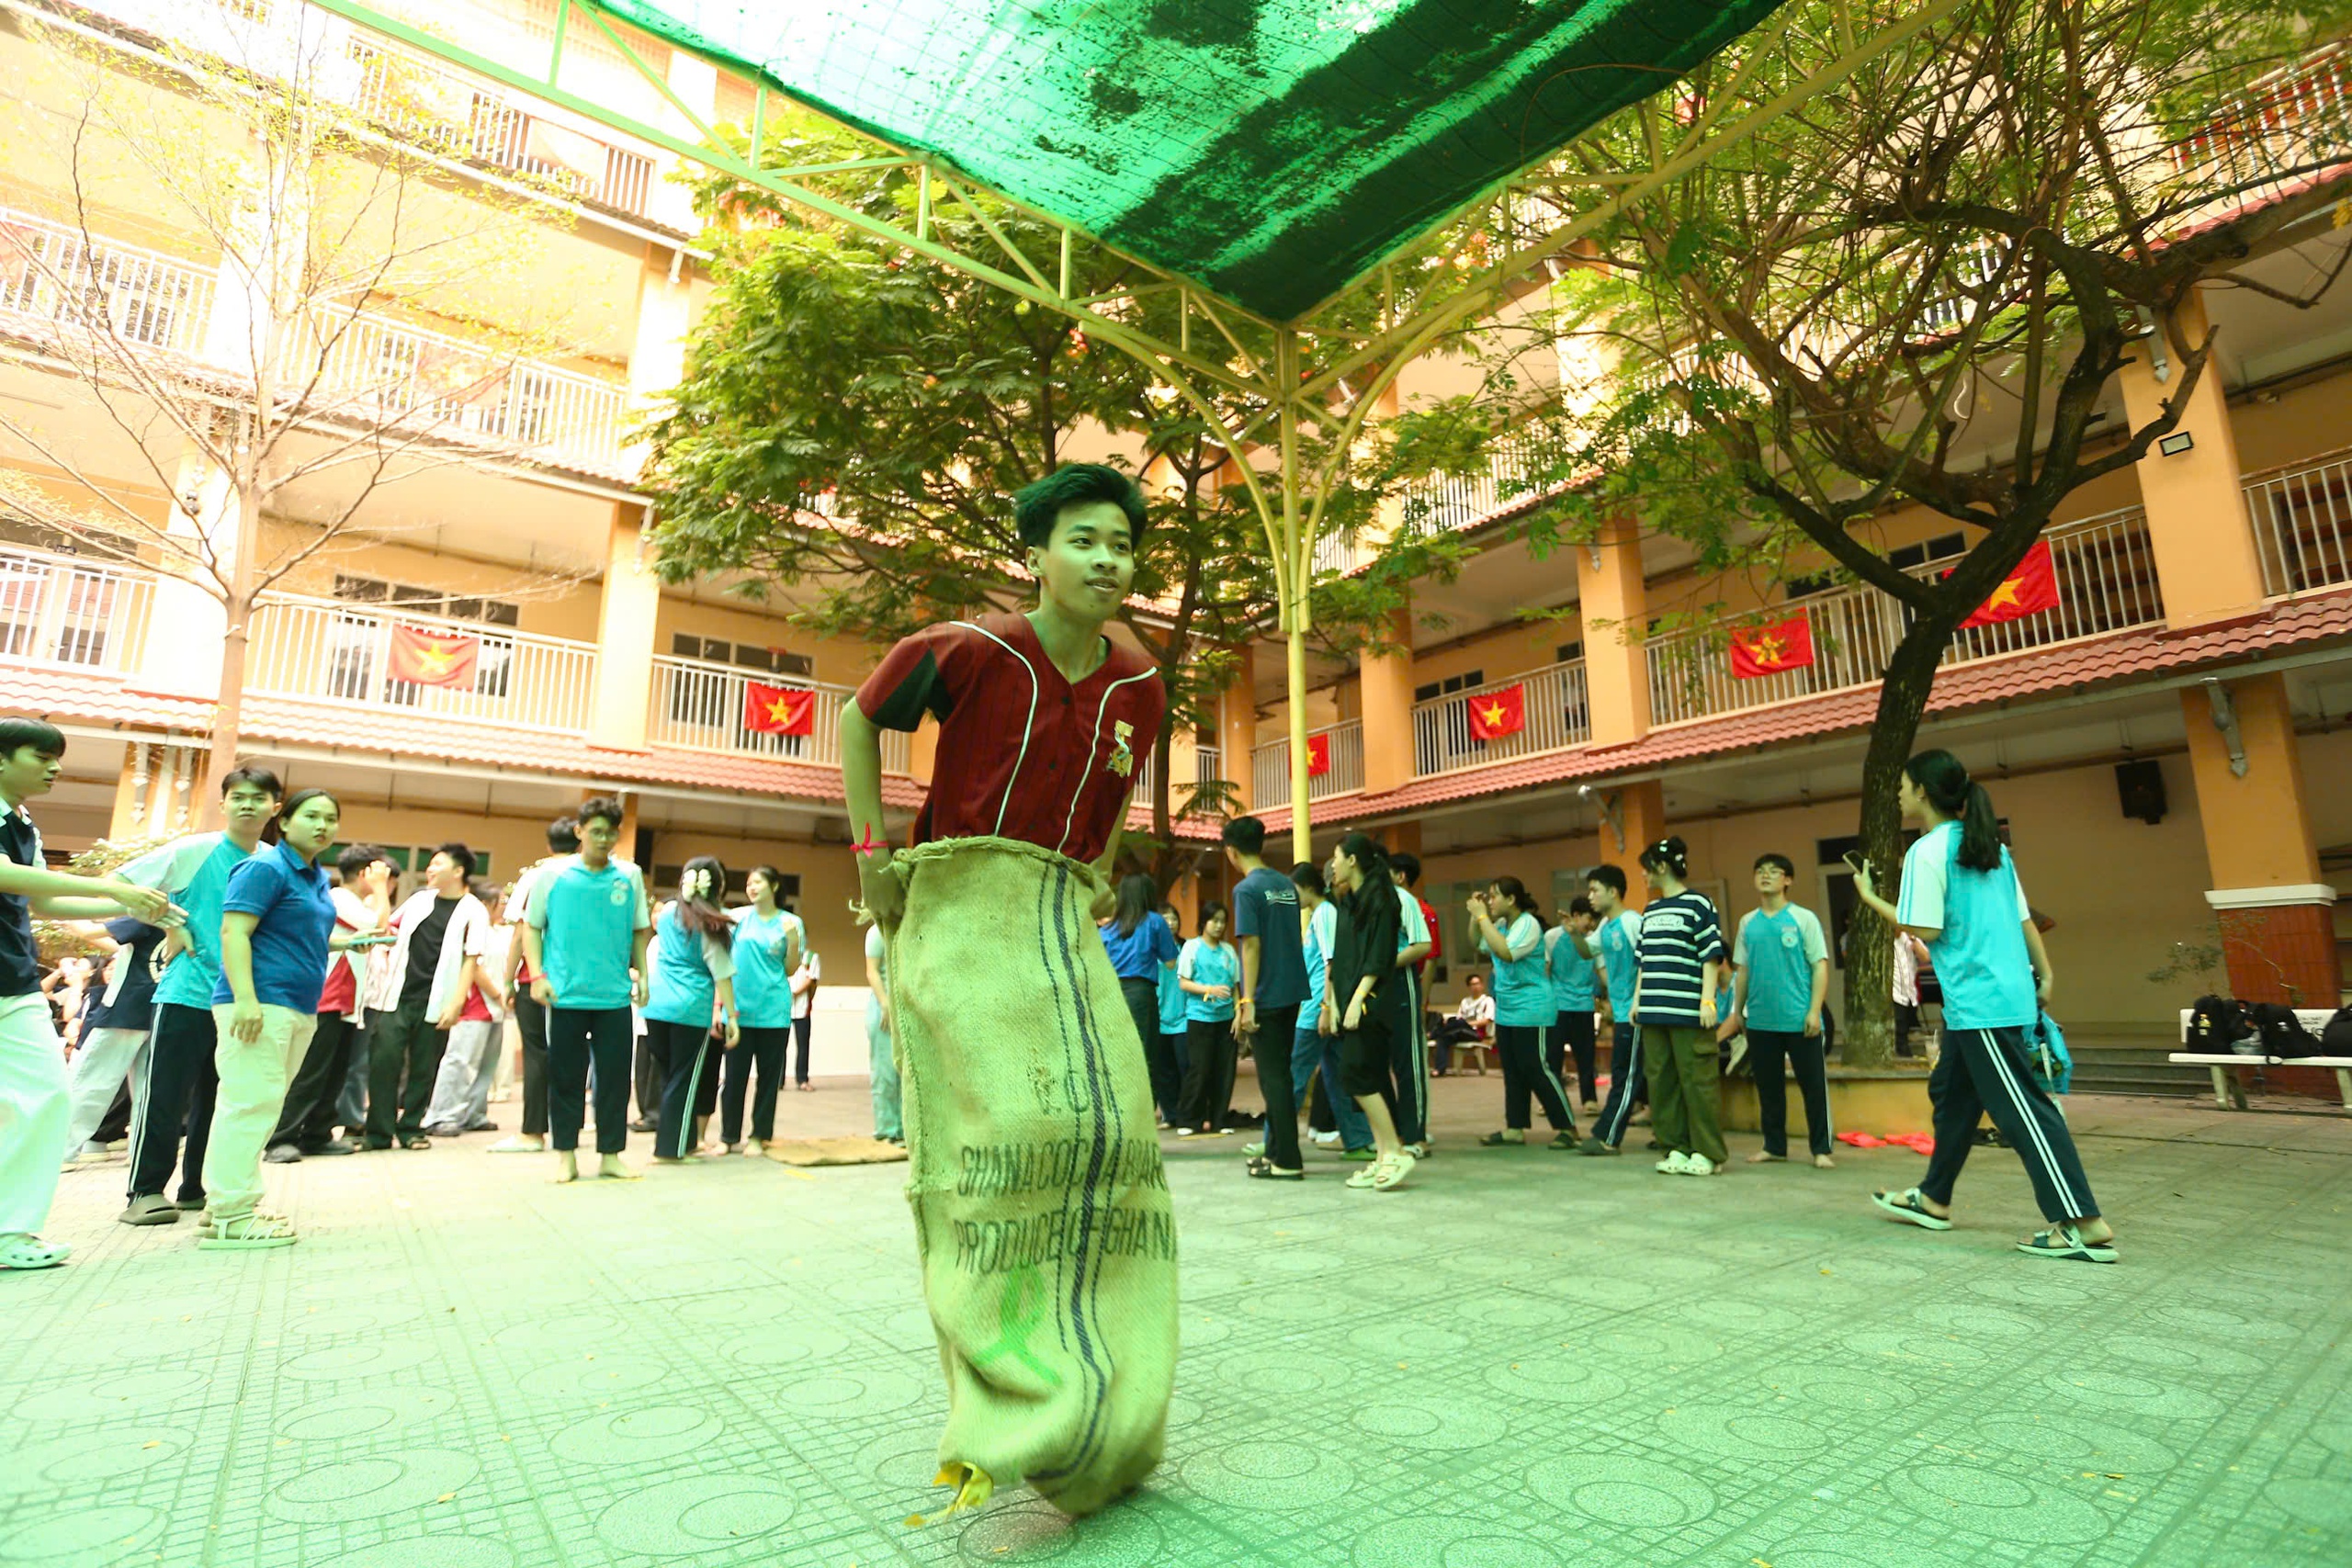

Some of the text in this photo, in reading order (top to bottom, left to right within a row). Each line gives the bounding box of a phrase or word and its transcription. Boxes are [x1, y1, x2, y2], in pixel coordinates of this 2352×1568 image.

[957, 1144, 1034, 1197] GHANA
[1037, 1138, 1120, 1190] COCA
[954, 1210, 1063, 1274] PRODUCE
